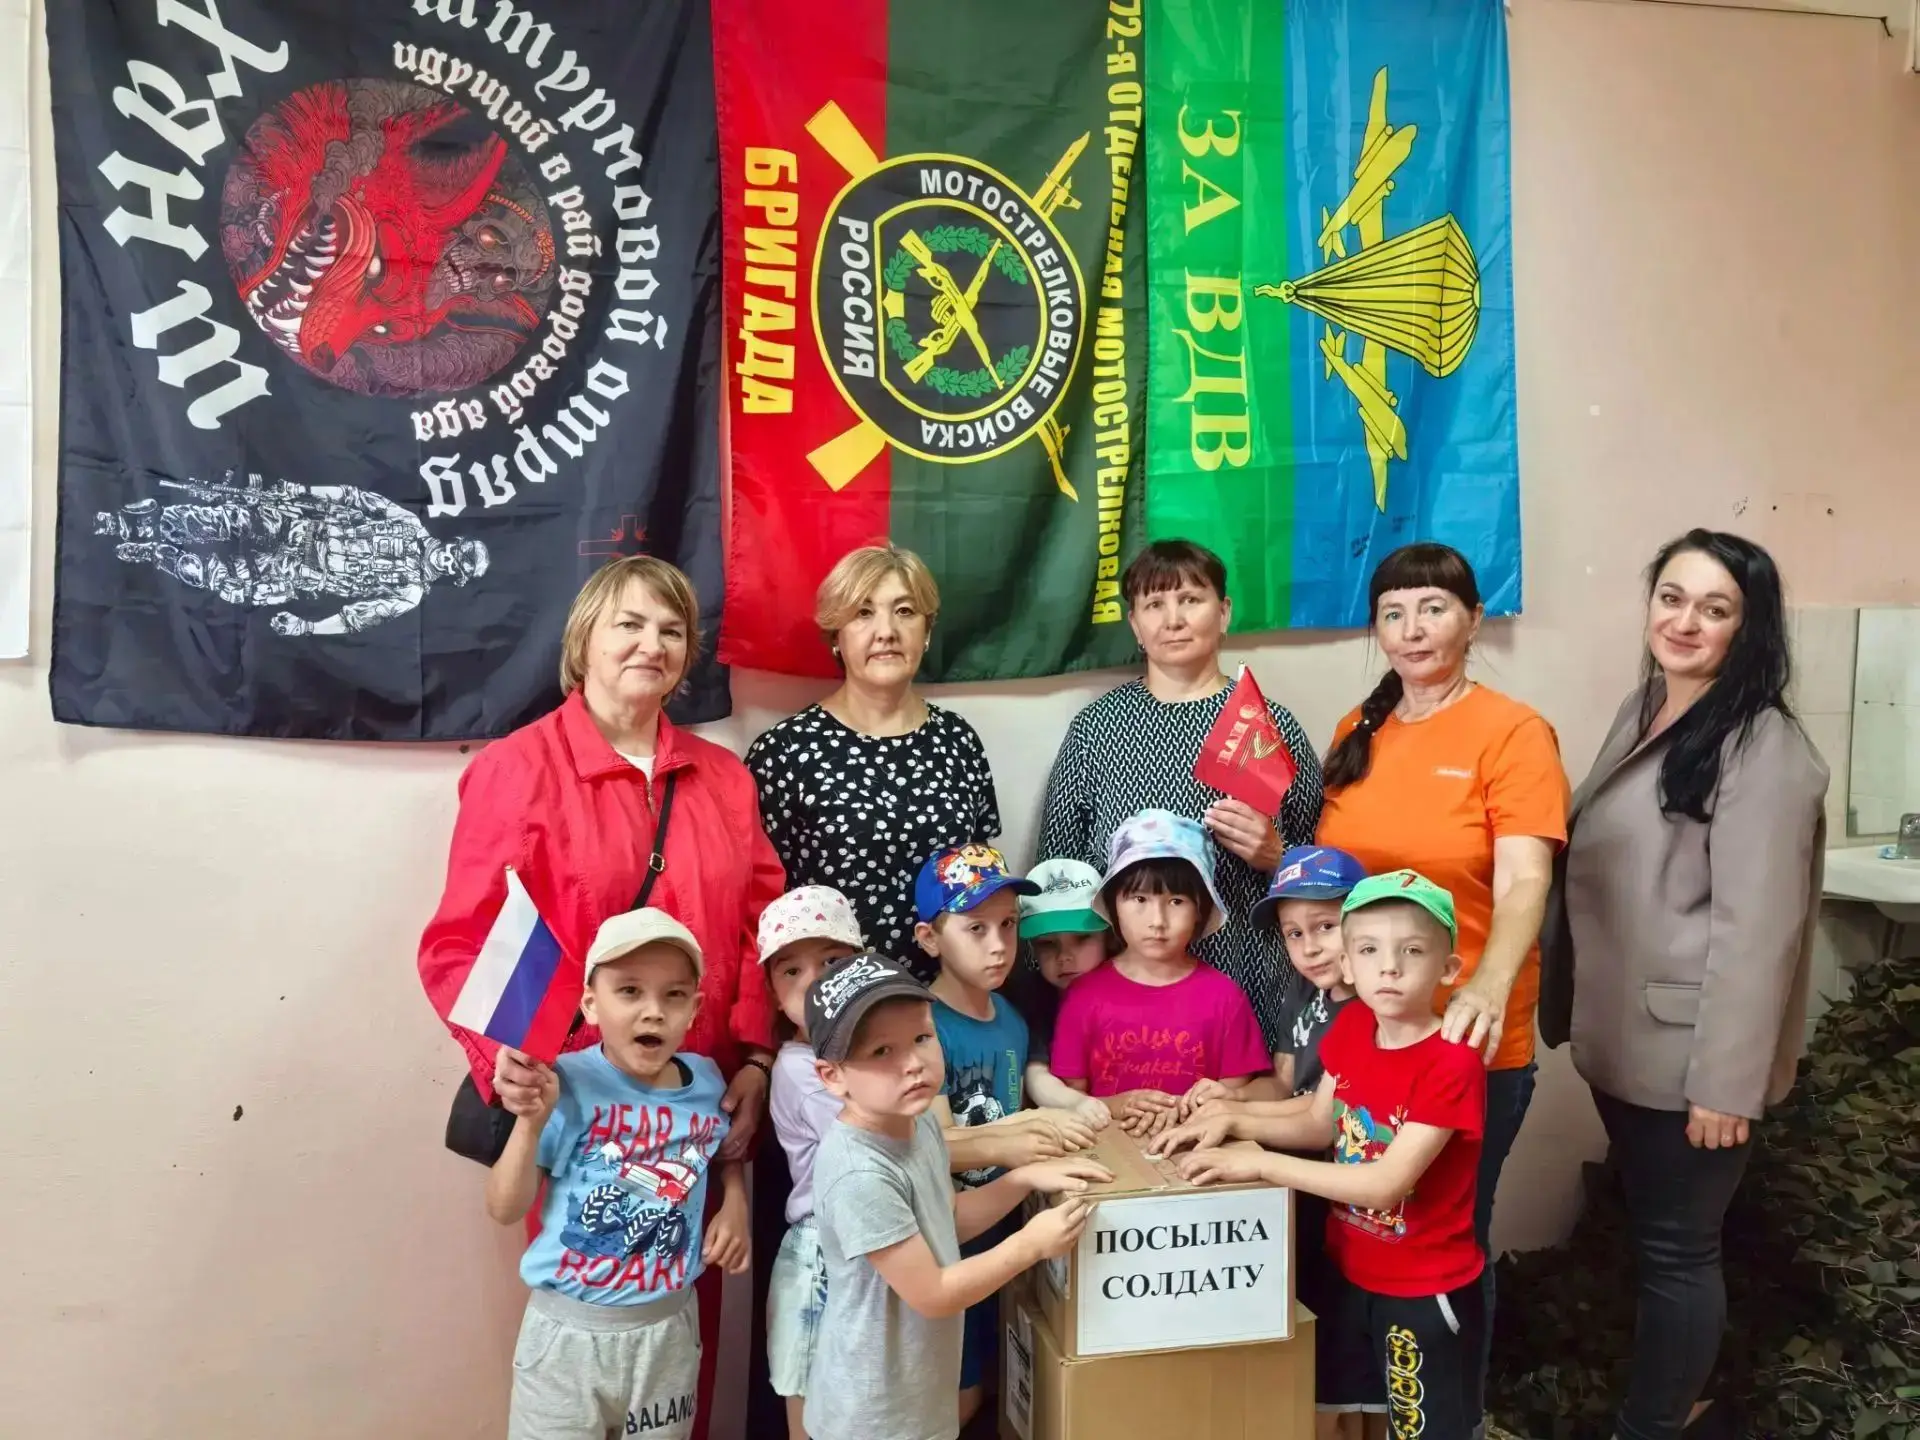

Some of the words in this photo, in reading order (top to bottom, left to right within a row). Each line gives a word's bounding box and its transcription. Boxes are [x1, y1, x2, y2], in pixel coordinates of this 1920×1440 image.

[1101, 81, 1142, 299] ОТДЕЛЬНАЯ
[1177, 104, 1241, 236] ЗА
[736, 147, 799, 413] БРИГАДА
[838, 215, 875, 378] РОССИЯ
[920, 168, 1074, 398] МОТОСТРЕЛКОВЫЕ
[920, 396, 1036, 448] ВОЙСКА
[1172, 267, 1252, 472] ВДВ
[1092, 307, 1131, 624] МОТОСТРЕЛКОВАЯ
[584, 1103, 674, 1162] HEAR
[554, 1248, 685, 1291] ROAR!
[1095, 1218, 1269, 1254] ПОСЫЛКА
[1102, 1264, 1264, 1300] СОЛДАТУ
